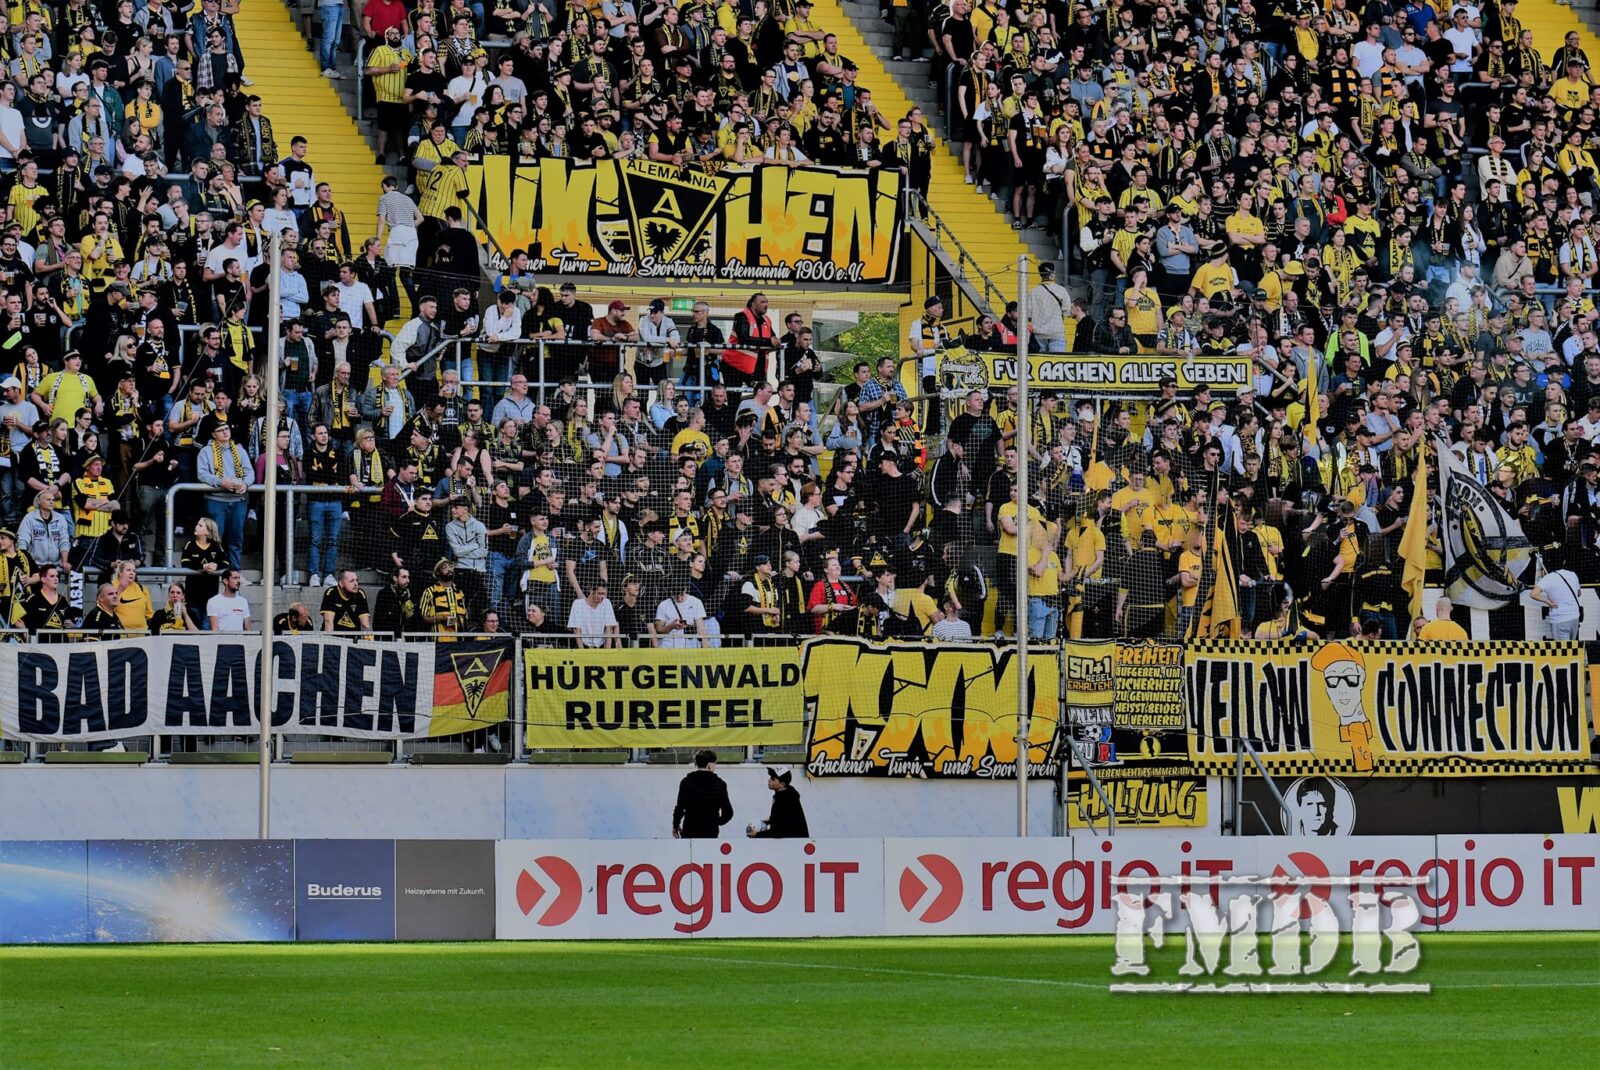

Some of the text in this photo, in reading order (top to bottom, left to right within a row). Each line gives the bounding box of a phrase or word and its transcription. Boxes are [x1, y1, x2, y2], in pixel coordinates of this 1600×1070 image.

[550, 248, 600, 274] Turn-
[607, 258, 633, 275] und
[637, 255, 718, 278] Sportverein
[720, 256, 790, 279] Alemannia
[795, 260, 835, 281] 1900
[1038, 361, 1114, 384] AACHEN
[1120, 361, 1176, 383] ALLES
[1181, 362, 1247, 384] GEBEN!
[17, 642, 419, 735] BAD AACHEN
[531, 660, 800, 691] HÜRTGENWALD
[1116, 678, 1181, 691] SICHERHEIT
[1116, 690, 1127, 701] ZU
[1148, 703, 1181, 713] BEIDES
[1186, 660, 1311, 754] YELLOW
[1377, 661, 1580, 752] CONNECTION
[565, 698, 774, 731] RUREIFEL
[1116, 714, 1181, 725] ZU VERLIEREN
[942, 757, 973, 776] und
[307, 883, 382, 897] Buderus
[405, 887, 445, 896] Heizsysteme
[459, 887, 486, 896] Zukunft.
[596, 842, 859, 933] regio iT
[980, 840, 1162, 929] regio
[1349, 839, 1595, 928] regio iT
